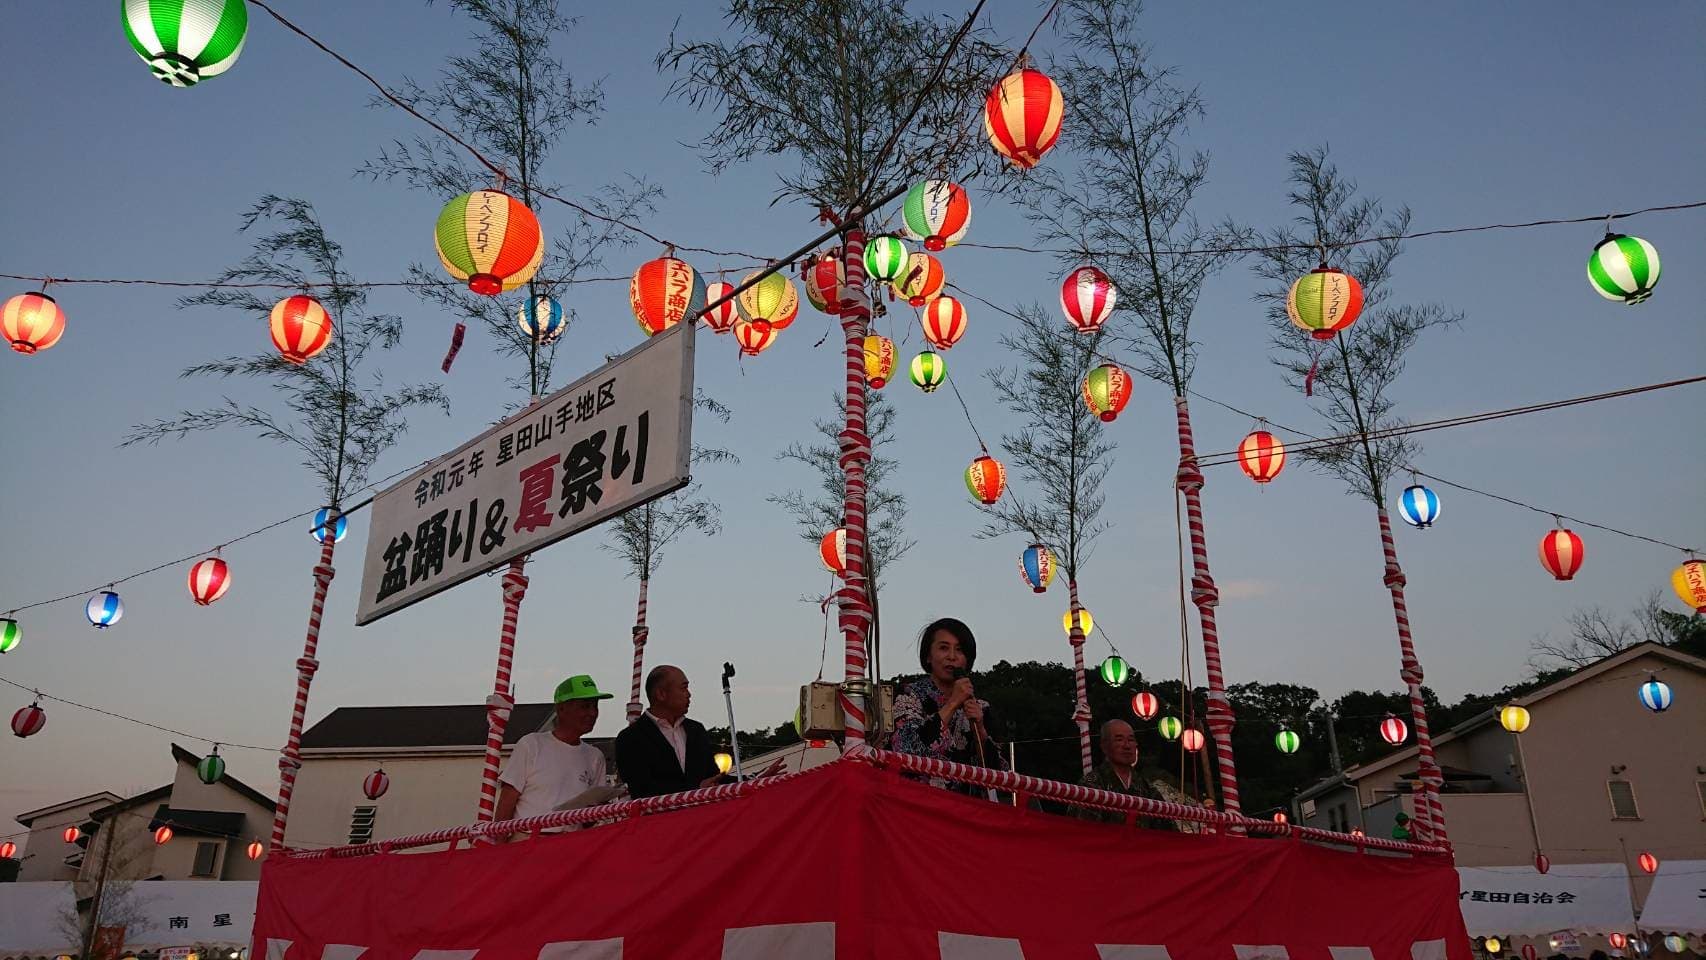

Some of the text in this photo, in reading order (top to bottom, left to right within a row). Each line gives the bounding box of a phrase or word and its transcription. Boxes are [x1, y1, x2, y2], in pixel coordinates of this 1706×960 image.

[664, 262, 690, 321] エハラ商店
[1109, 367, 1123, 410] エハラ商店
[414, 377, 616, 509] 令和元年 星田山手地区
[375, 411, 649, 604] 盆踊り&夏祭り
